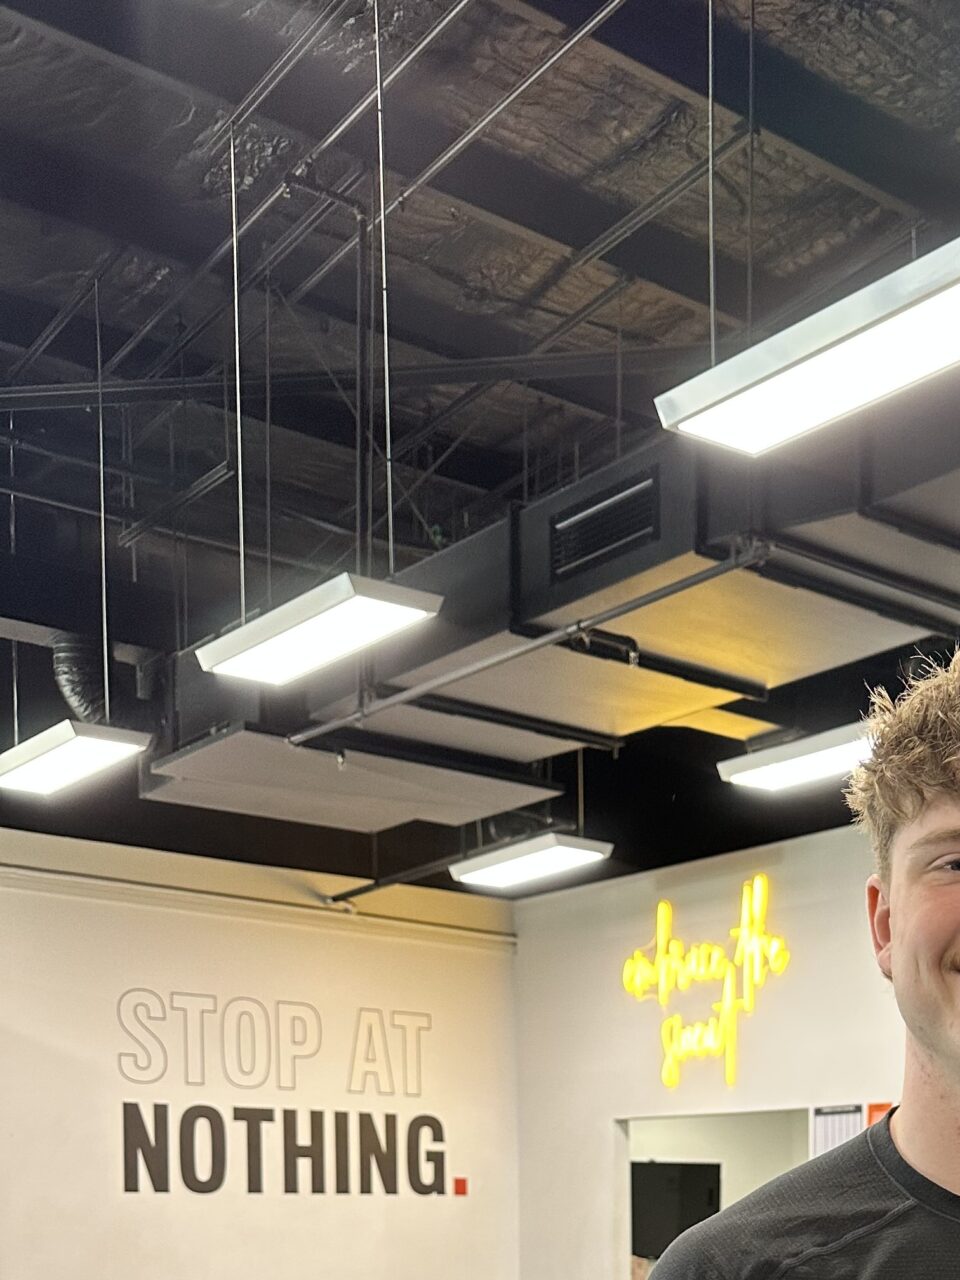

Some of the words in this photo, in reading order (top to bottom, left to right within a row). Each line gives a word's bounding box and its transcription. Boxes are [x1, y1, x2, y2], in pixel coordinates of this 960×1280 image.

[117, 987, 322, 1090] STOP
[348, 1007, 432, 1096] AT
[122, 1101, 468, 1196] NOTHING.
